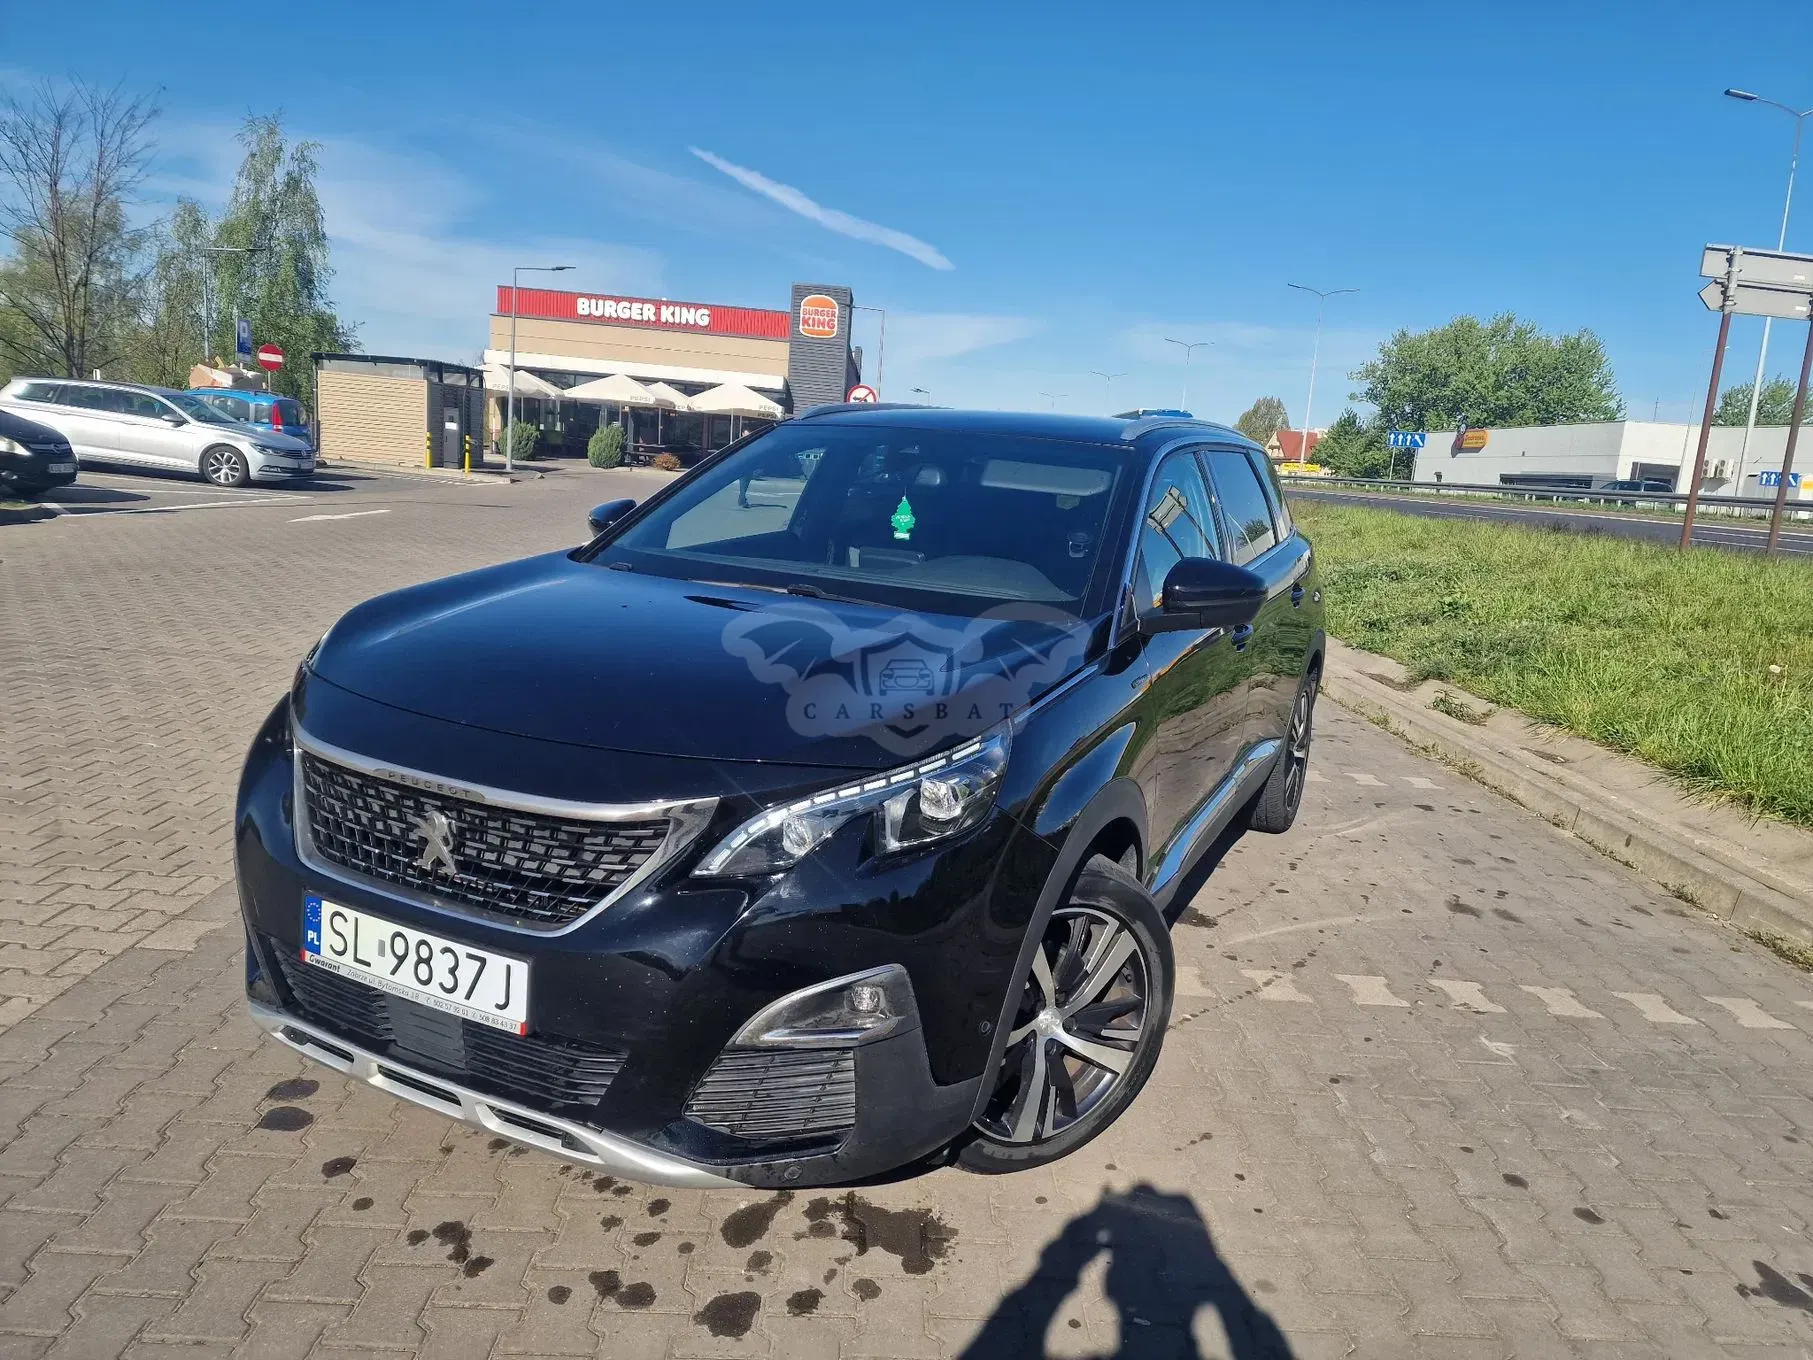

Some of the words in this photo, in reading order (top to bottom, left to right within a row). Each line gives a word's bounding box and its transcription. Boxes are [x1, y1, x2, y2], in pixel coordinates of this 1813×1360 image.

[577, 298, 656, 321] BURGER
[661, 305, 710, 326] KING
[802, 307, 836, 318] BURGER
[801, 316, 836, 330] KING
[388, 771, 471, 798] PEUGEOT
[307, 929, 320, 945] PL
[309, 954, 340, 972] Gwarant
[329, 910, 373, 968] SL
[389, 931, 512, 1010] 9837J
